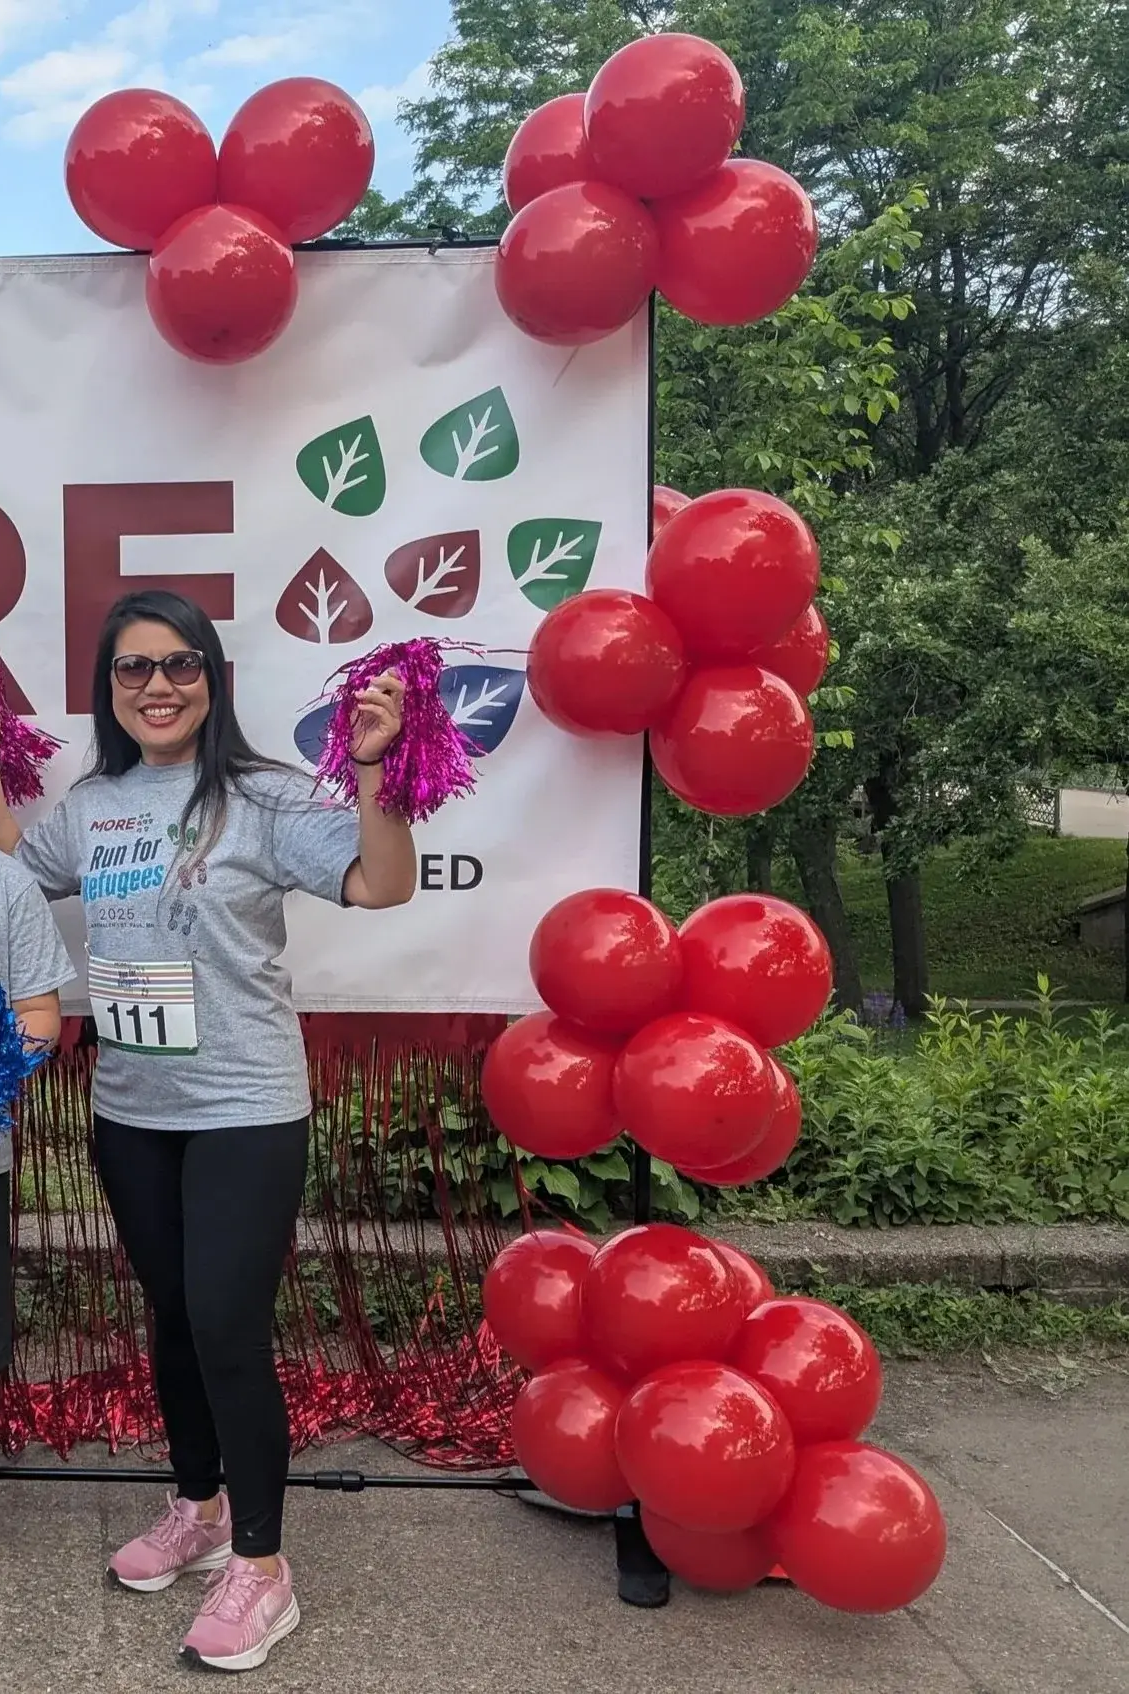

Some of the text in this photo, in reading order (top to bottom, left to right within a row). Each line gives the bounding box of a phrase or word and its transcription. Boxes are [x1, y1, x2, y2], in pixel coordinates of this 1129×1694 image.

[89, 816, 136, 833] MORE
[90, 837, 162, 872] Run for
[83, 864, 165, 904] Refugees
[98, 908, 135, 920] 2025
[107, 1002, 168, 1046] 111
